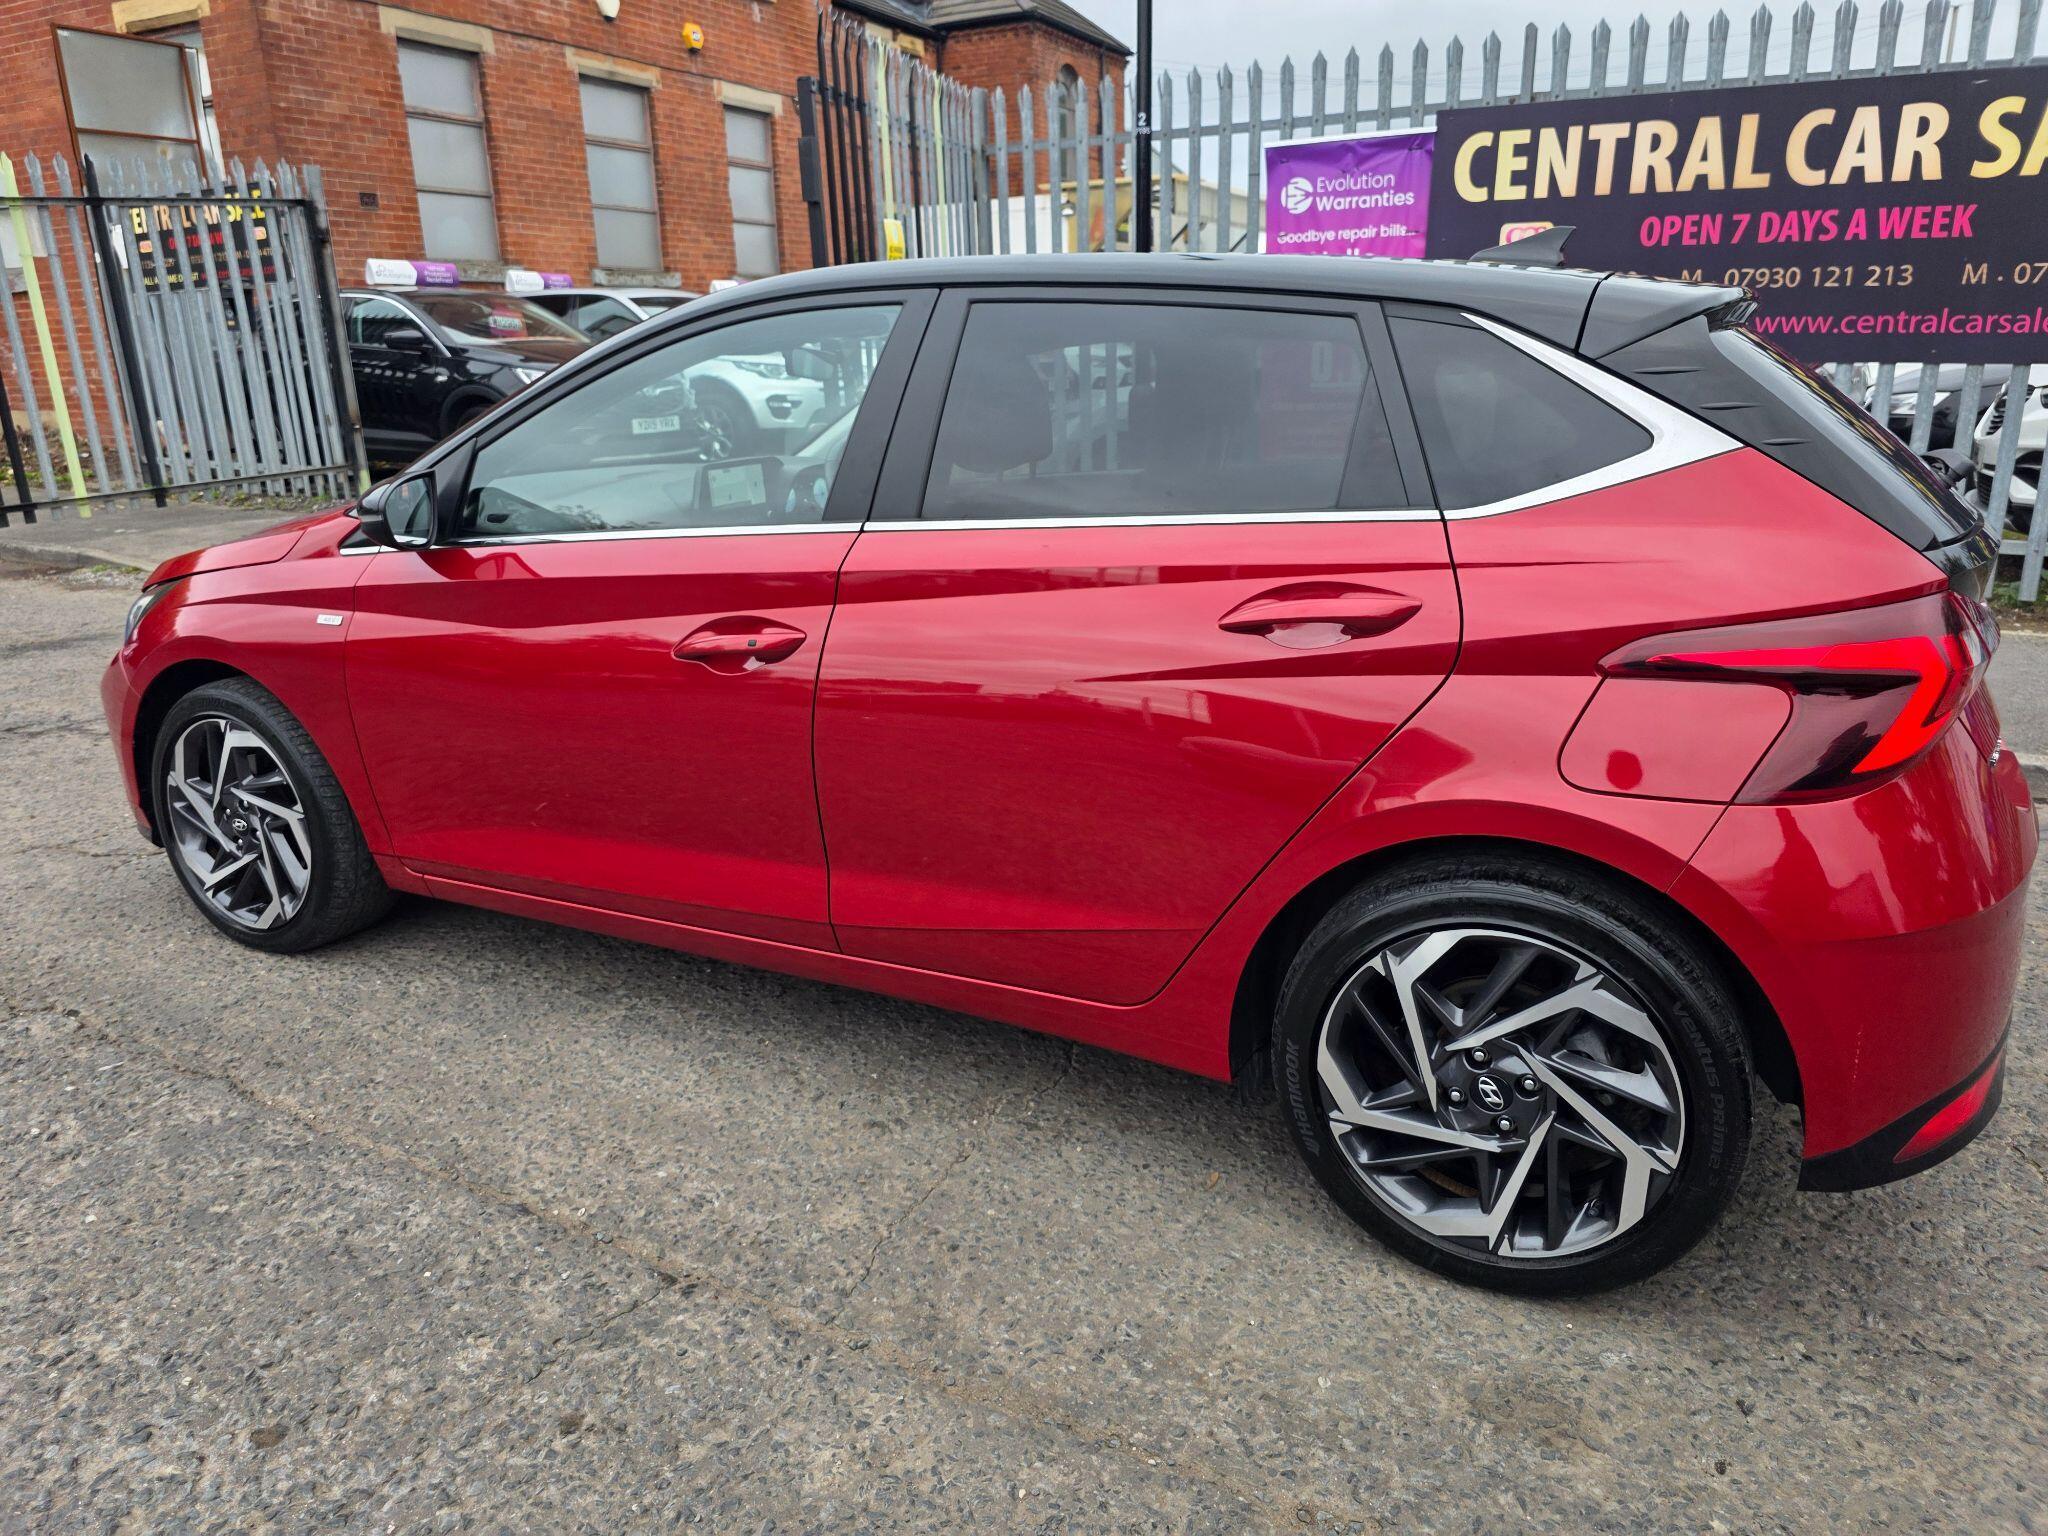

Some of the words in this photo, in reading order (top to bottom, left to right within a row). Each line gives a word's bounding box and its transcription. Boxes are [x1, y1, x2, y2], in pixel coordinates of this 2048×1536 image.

[1453, 113, 1771, 203] CENTRAL
[1785, 102, 1950, 187] CAR
[1316, 172, 1396, 193] Evolution
[1316, 190, 1416, 212] Warranties
[1277, 228, 1336, 245] Goodbye
[1337, 225, 1378, 242] repair
[1640, 213, 1723, 247] OPEN
[1730, 213, 1750, 245] 7
[1757, 209, 1839, 243] DAYS
[1844, 208, 1867, 241] A
[1878, 204, 1979, 240] WEEK
[1723, 266, 1801, 288] 07930
[1811, 265, 1855, 287] 121
[1863, 263, 1914, 287] 213
[1961, 263, 1988, 285] M
